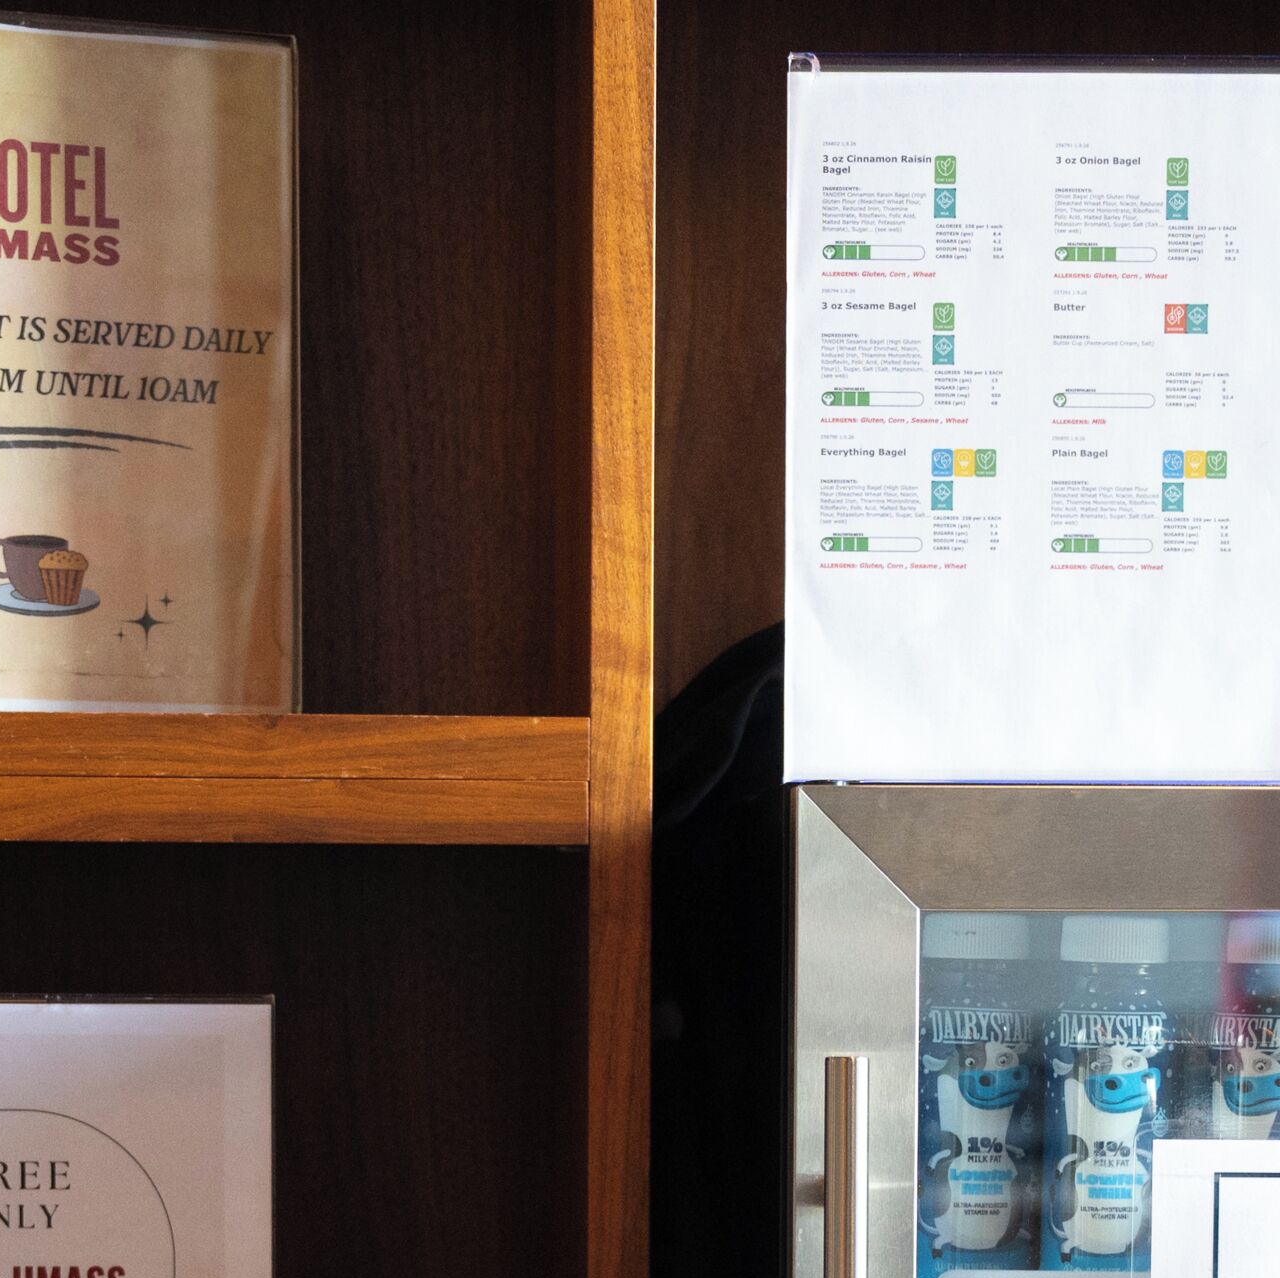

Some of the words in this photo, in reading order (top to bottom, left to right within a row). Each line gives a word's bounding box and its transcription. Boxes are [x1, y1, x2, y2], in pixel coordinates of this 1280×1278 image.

[823, 155, 829, 163] 3
[847, 155, 897, 163] Cinnamon
[901, 155, 932, 163] Raisin
[1056, 156, 1061, 164] 3
[1080, 156, 1109, 165] Onion
[1113, 157, 1141, 166] Bagel
[823, 166, 851, 174] Bagel
[822, 302, 827, 310] 3
[845, 302, 885, 310] Sesame
[889, 302, 916, 311] Bagel
[1054, 303, 1086, 311] Butter
[17, 316, 47, 342] IS
[53, 318, 175, 349] SERVED
[182, 327, 272, 355] DAILY
[35, 370, 130, 400] UNTIL
[140, 376, 219, 405] 10AM
[821, 448, 875, 458] Everything
[879, 448, 906, 457] Bagel
[1052, 449, 1076, 457] Plain
[1080, 449, 1108, 459] Bagel
[1058, 1012, 1167, 1047] DAIRYSTAR
[968, 1137, 1003, 1153] 1%
